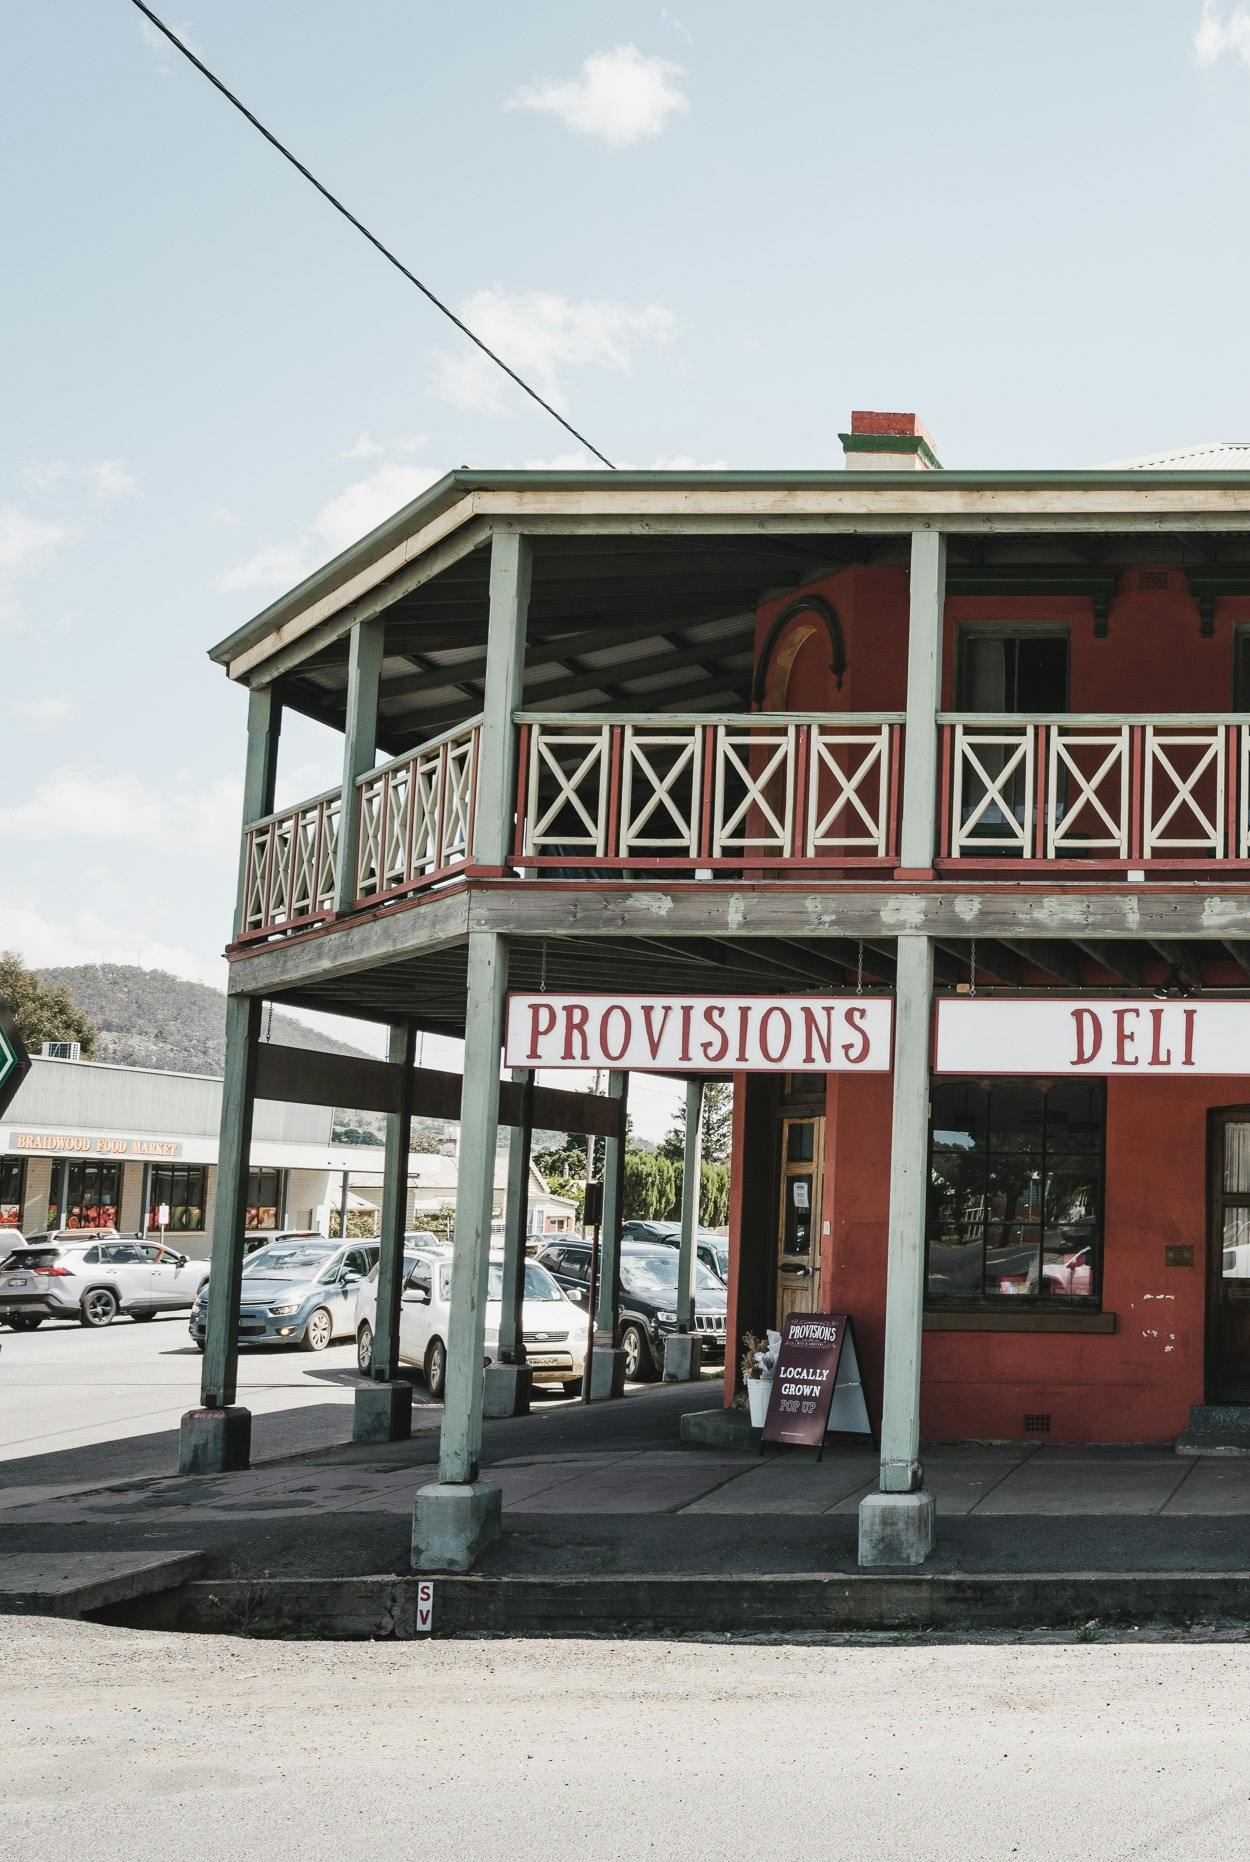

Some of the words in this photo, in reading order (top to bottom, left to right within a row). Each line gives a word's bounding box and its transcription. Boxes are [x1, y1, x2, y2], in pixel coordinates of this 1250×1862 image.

[526, 1003, 871, 1064] PROVISIONS
[1070, 1007, 1198, 1066] DELI
[16, 1134, 91, 1151] BRAIDWOOD
[95, 1138, 127, 1153] FOOD
[132, 1141, 177, 1156] MARKET
[788, 1324, 837, 1342] PROVISIONS
[779, 1366, 830, 1381] LOCALLY
[781, 1383, 821, 1397] GROWN
[779, 1399, 800, 1413] POP
[801, 1401, 817, 1414] UP
